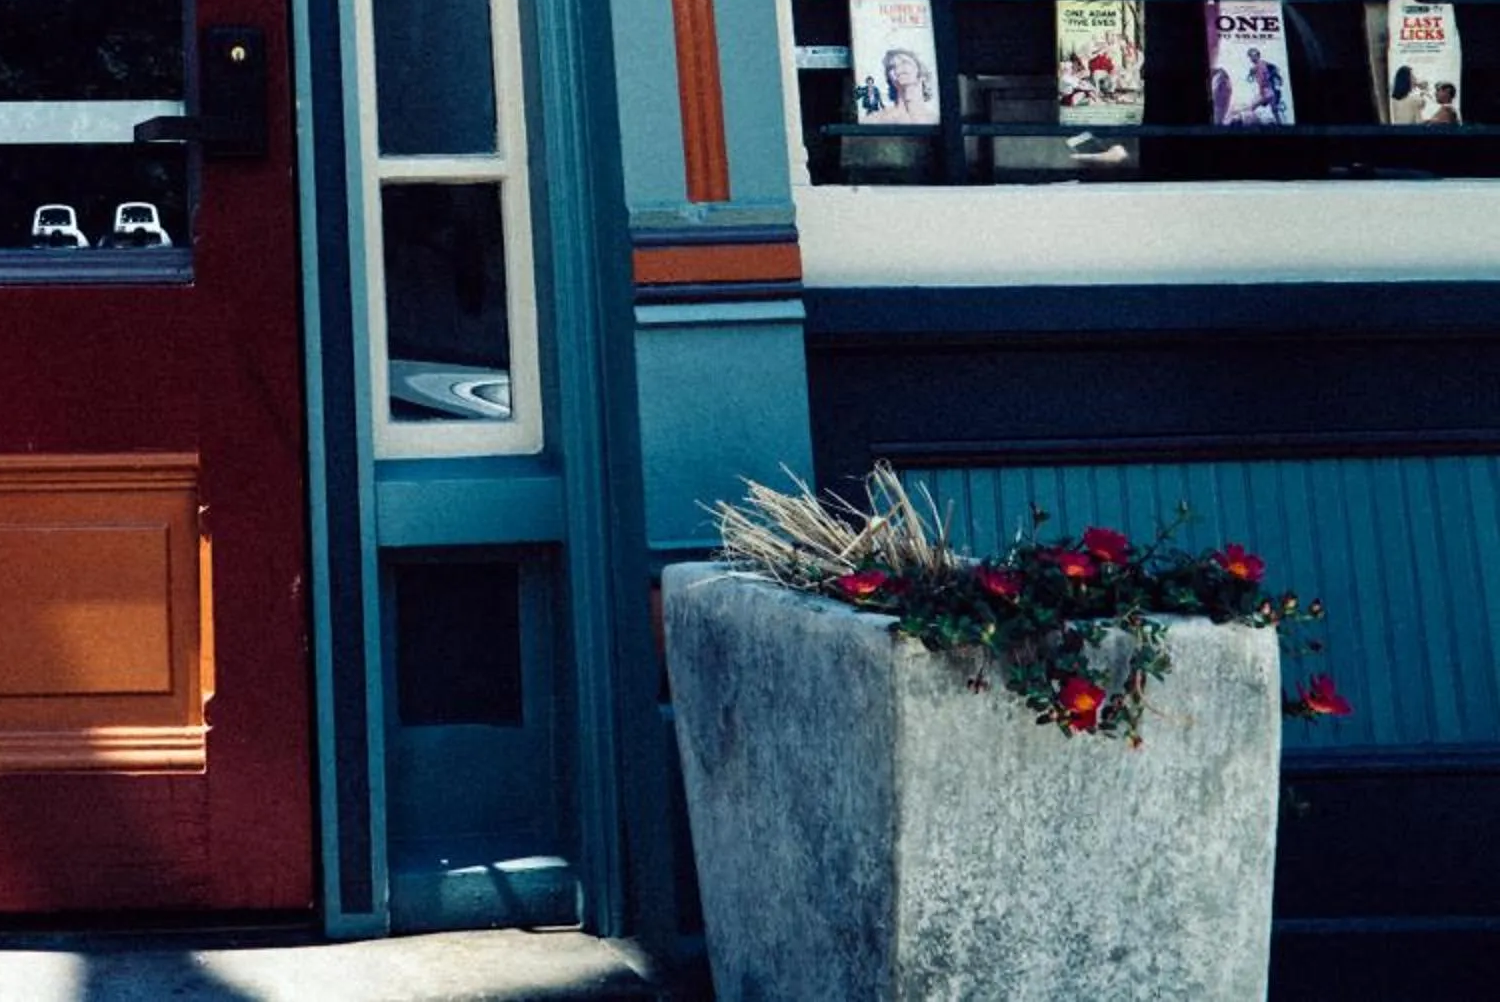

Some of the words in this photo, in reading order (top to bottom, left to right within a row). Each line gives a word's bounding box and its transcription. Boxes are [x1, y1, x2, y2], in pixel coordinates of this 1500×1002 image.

[1064, 9, 1085, 18] ONE
[1088, 9, 1117, 18] ADAM
[1091, 18, 1117, 27] EVES
[1214, 15, 1281, 32] ONE
[1402, 16, 1442, 29] LAST
[1400, 29, 1445, 41] LICKS
